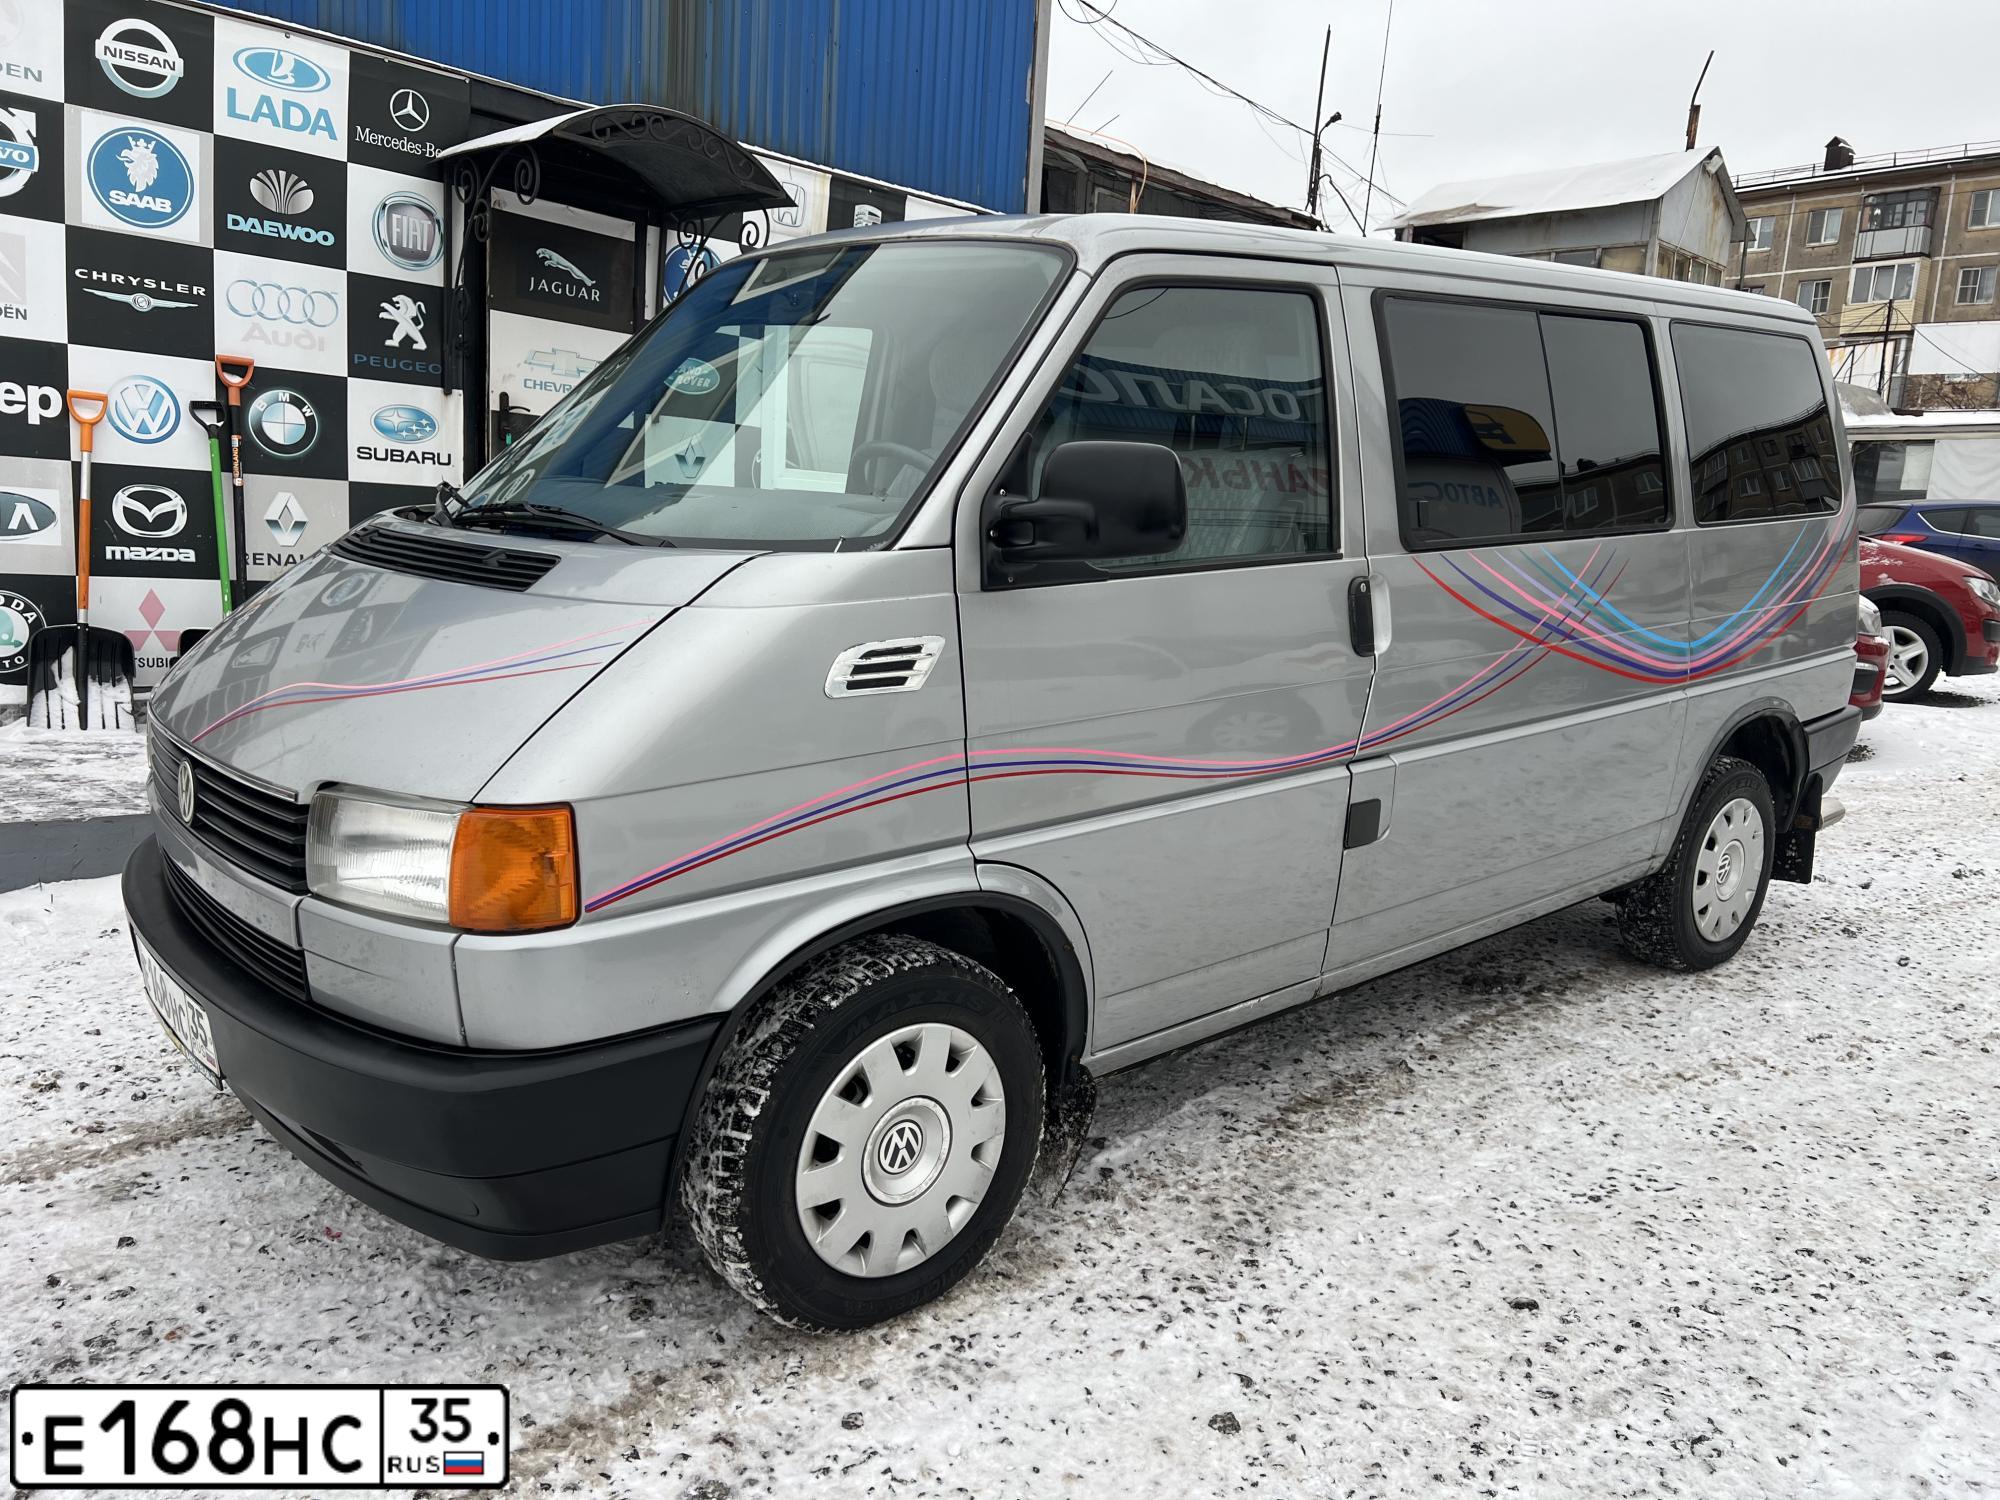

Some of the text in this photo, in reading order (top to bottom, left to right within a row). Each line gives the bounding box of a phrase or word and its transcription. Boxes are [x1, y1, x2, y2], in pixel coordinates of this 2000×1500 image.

[103, 45, 176, 72] NISSAN
[226, 87, 338, 141] LADA
[355, 126, 443, 158] Mercedes-Be
[109, 189, 172, 213] SAAB
[227, 213, 335, 246] DAEWOO
[391, 213, 431, 252] FIAT
[74, 268, 206, 296] CHRYSLER
[529, 276, 600, 302] JAGUAR
[0, 303, 27, 320] ËN
[240, 323, 325, 352] Audi
[354, 353, 442, 374] PEUGEO
[524, 378, 573, 394] CHEVR
[357, 446, 452, 466] SUBARU
[244, 552, 304, 567] ENA
[134, 657, 168, 668] SUBI
[188, 1001, 207, 1047] 35
